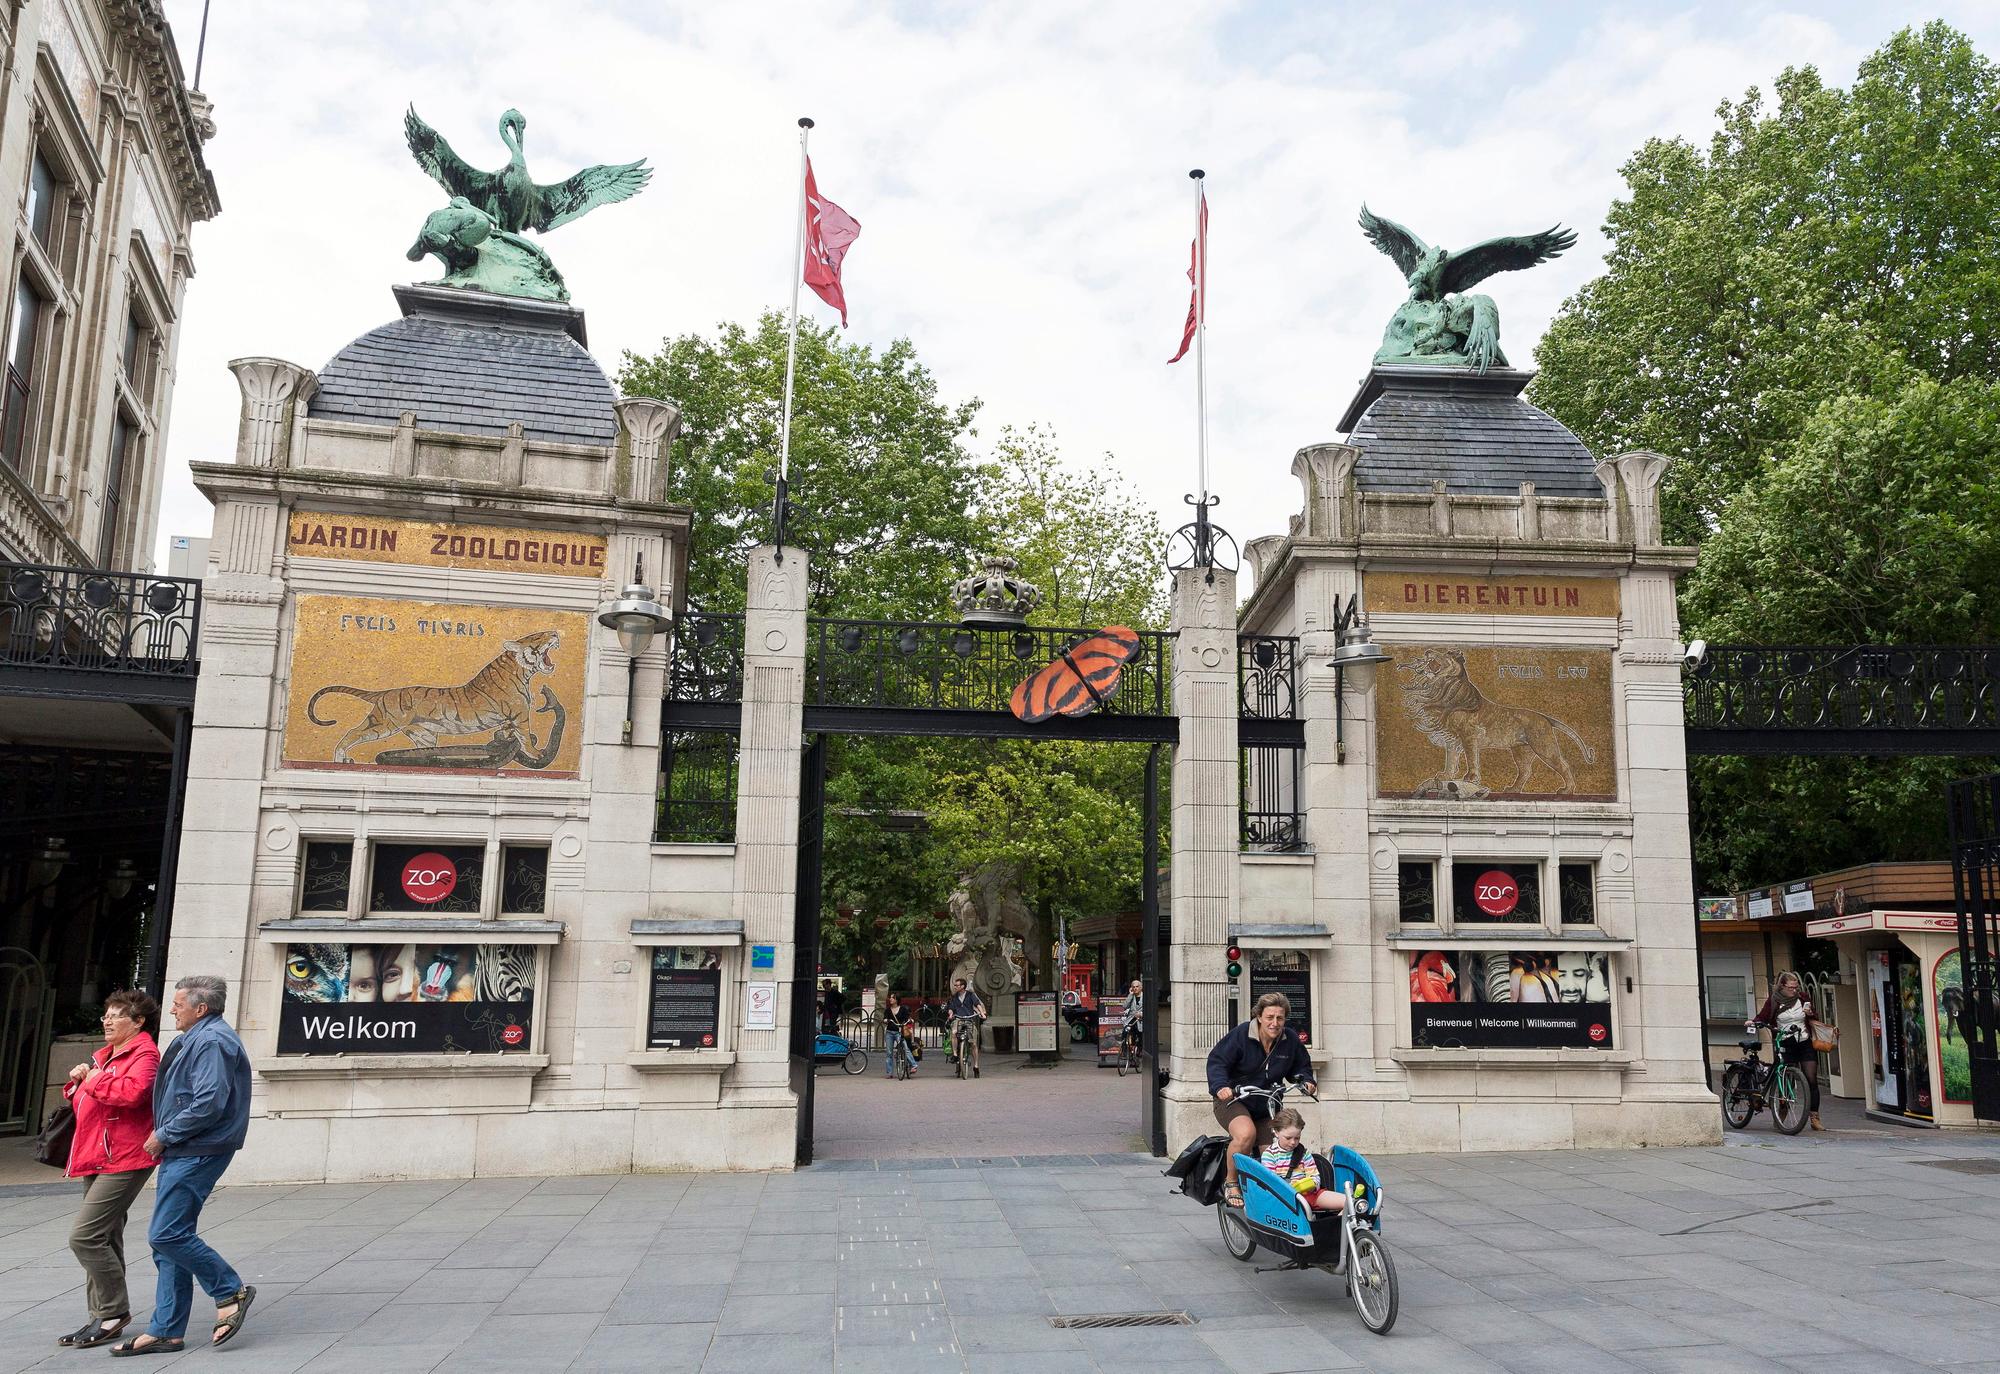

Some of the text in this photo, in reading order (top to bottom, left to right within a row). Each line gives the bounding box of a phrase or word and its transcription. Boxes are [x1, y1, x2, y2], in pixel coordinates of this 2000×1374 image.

[290, 523, 606, 567] JARDIN ZOOLOGIQUE
[1404, 583, 1579, 607] DIERENTUIN
[340, 614, 485, 636] FELIS TIGRIS
[1557, 666, 1589, 679] LEO
[302, 1016, 416, 1039] Welkom
[1426, 1018, 1577, 1028] Bienvenue Welcome Willkommen
[1265, 1214, 1298, 1233] Gazelle
